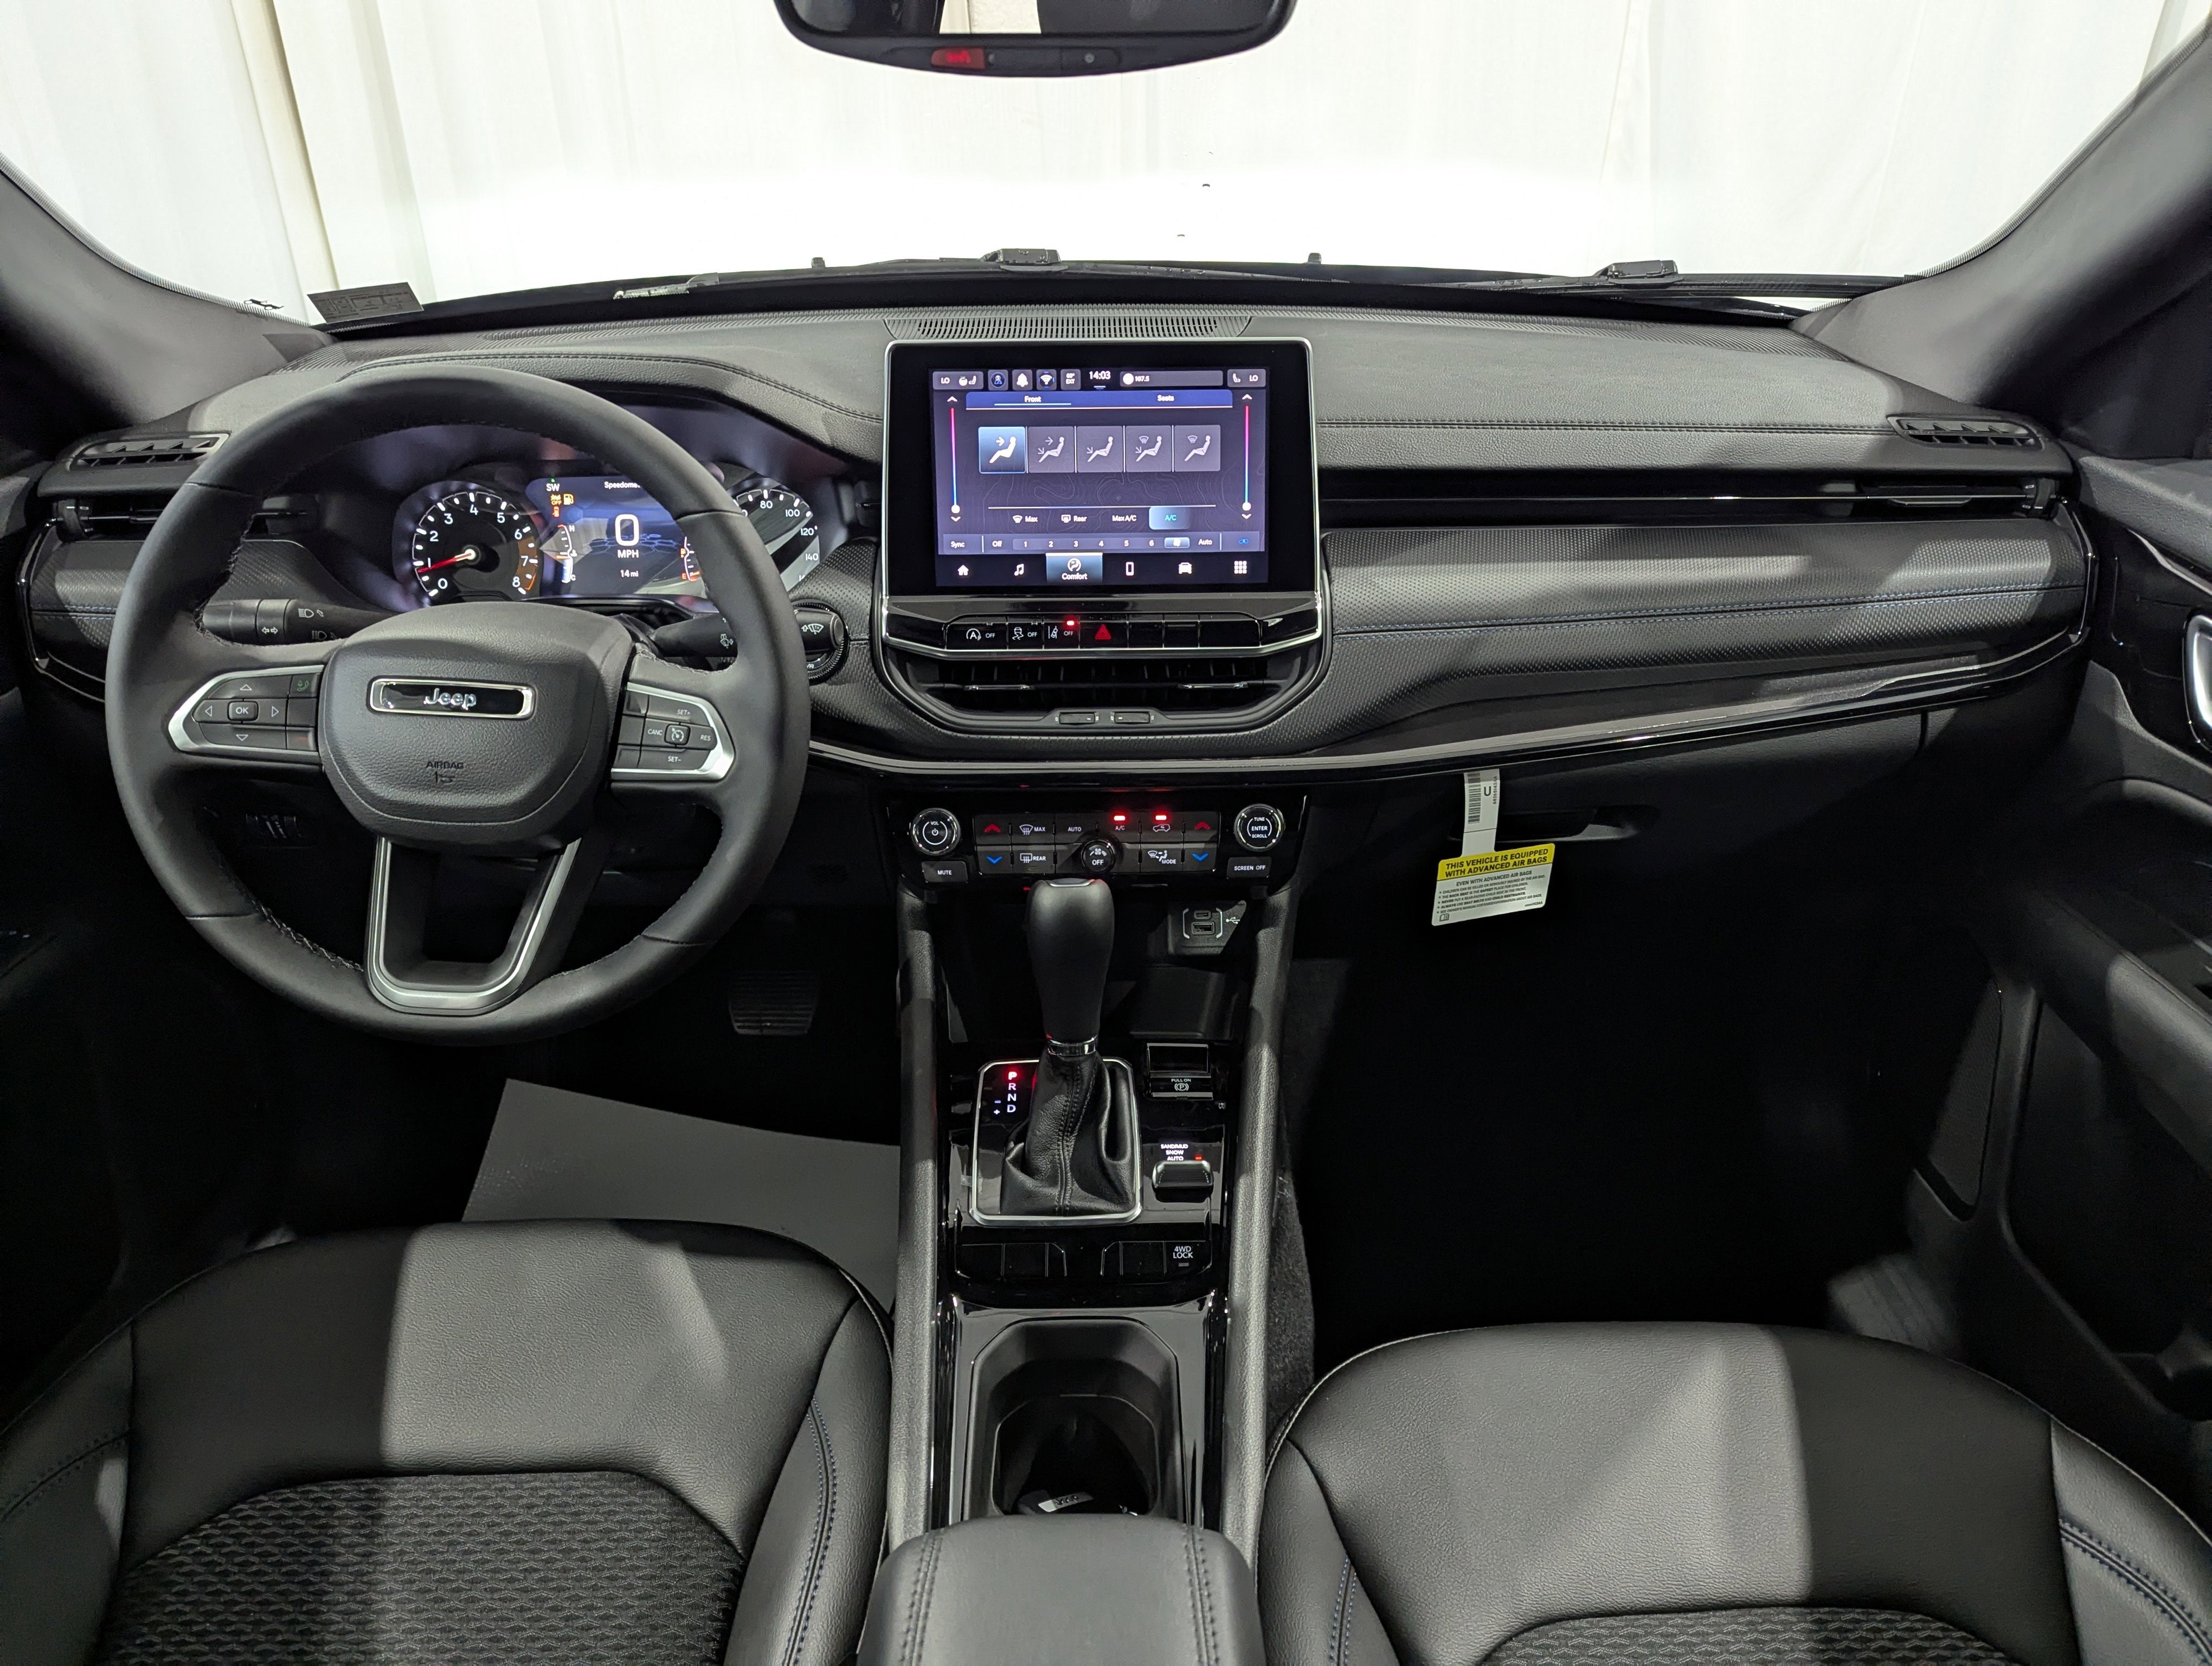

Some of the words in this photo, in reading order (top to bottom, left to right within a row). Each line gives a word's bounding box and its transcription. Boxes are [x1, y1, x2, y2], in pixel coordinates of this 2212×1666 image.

[1089, 370, 1111, 380] 14:03
[546, 483, 560, 492] SW
[604, 481, 640, 490] Speedome
[760, 500, 773, 509] 80
[470, 504, 478, 515] 4
[785, 509, 800, 517] 100
[444, 513, 453, 524] 3
[497, 512, 505, 523] 5
[514, 529, 522, 540] 6
[615, 514, 640, 546] 0
[800, 528, 814, 536] 120
[429, 530, 439, 542] 2
[950, 541, 965, 549] Sync
[617, 550, 639, 558] MPH
[805, 553, 819, 561] 140
[428, 558, 432, 568] 1
[520, 555, 529, 566] 7
[620, 569, 629, 578] 14
[438, 578, 448, 589] 0
[512, 576, 520, 587] 8
[425, 688, 477, 710] Jeep
[235, 707, 249, 715] OK
[426, 761, 464, 770] AIRBAG
[1484, 786, 1491, 797] U
[1445, 861, 1464, 870] THIS
[1466, 856, 1499, 867] VEHICLE
[1510, 848, 1548, 860] EQUIPPED
[1445, 869, 1465, 877] WITH
[1467, 862, 1510, 874] ADVANCED
[1512, 859, 1525, 867] AIR
[1527, 856, 1547, 864] BAGS
[1483, 874, 1509, 882] ADVANCED
[1008, 1071, 1018, 1080] P
[1007, 1093, 1017, 1101] N
[1007, 1104, 1016, 1113] D
